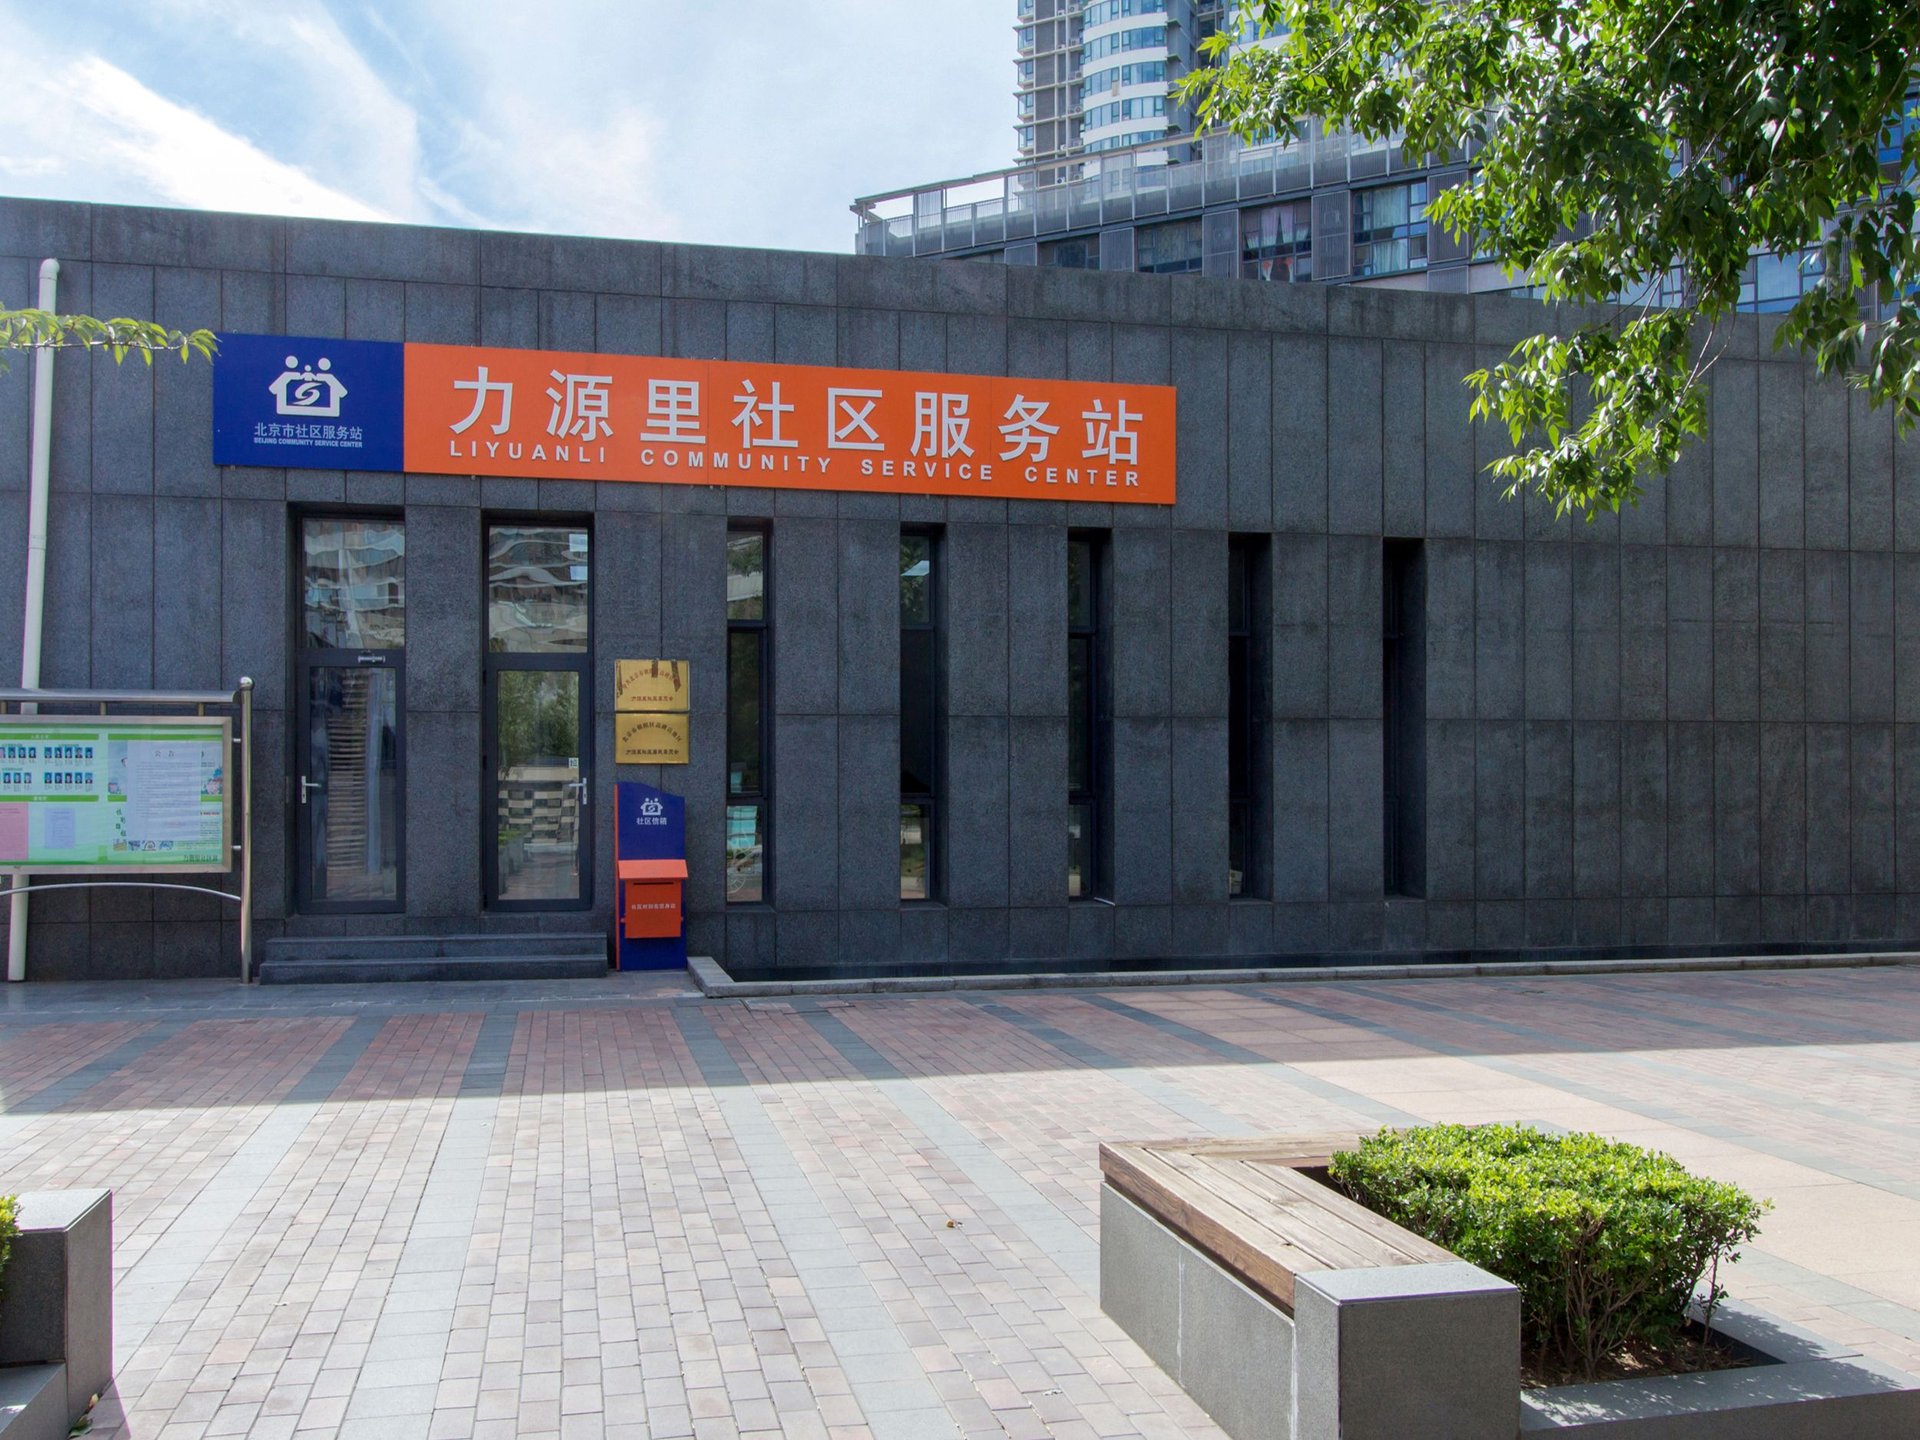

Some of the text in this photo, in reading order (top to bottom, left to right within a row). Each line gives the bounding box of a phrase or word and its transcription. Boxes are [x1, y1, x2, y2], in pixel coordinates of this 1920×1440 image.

[450, 366, 1143, 465] 力源里社区服务站
[254, 422, 363, 441] 北京市社区服务站
[254, 437, 363, 449] BEIJING COMMUNITY SERVICE CENTER
[450, 440, 1139, 487] LIYUANLI COMMUNITY SERVICE CENTER
[636, 817, 667, 826] 社区信箱
